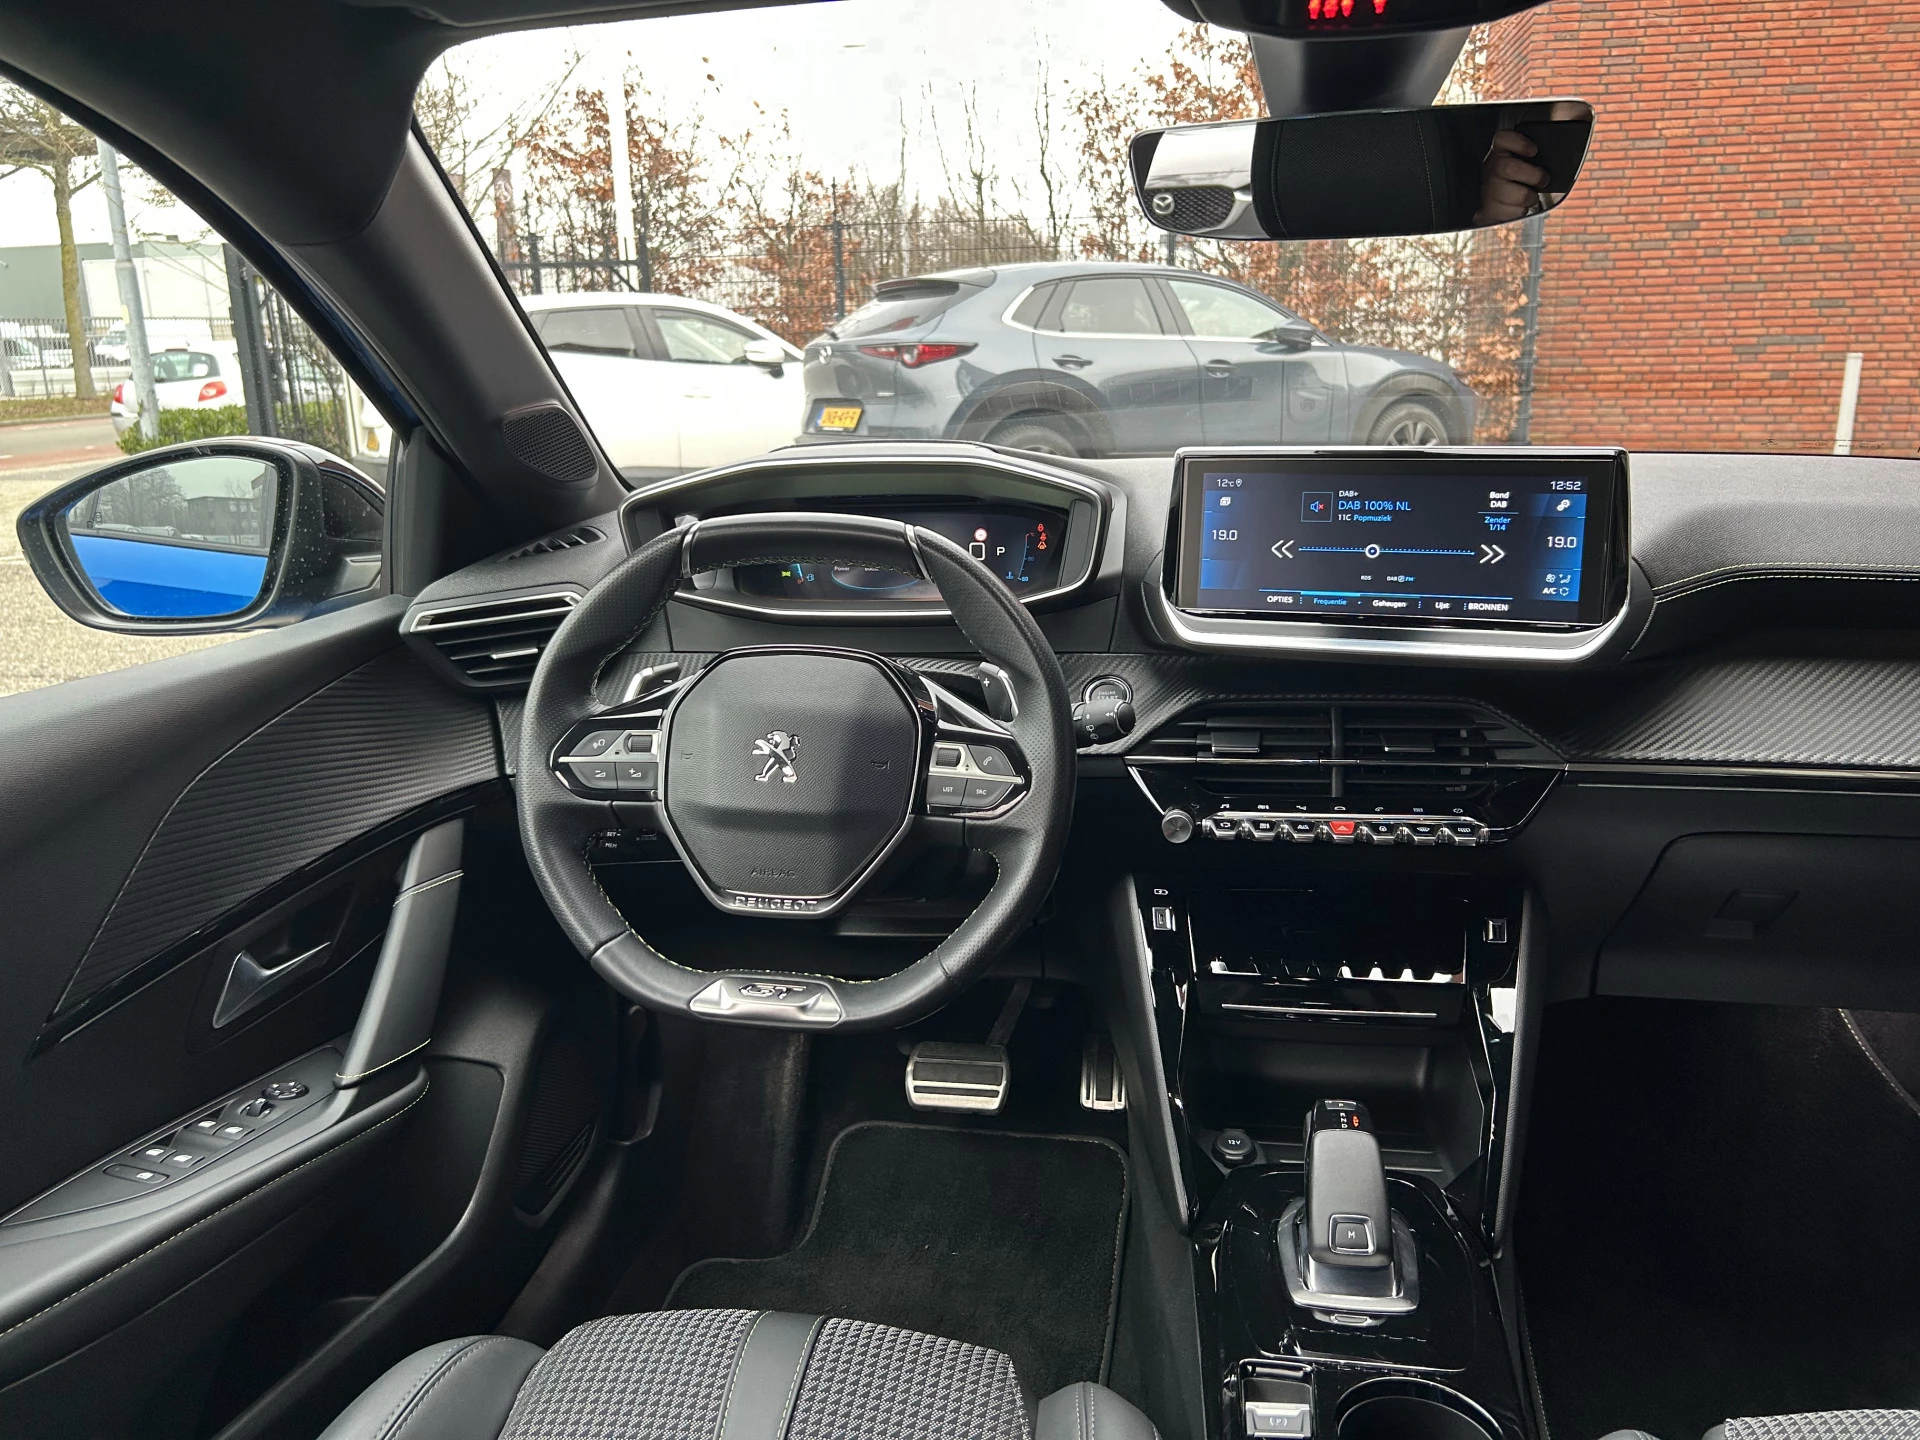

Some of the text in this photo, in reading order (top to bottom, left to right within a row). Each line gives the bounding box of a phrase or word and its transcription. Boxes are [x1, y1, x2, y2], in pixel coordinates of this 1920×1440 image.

[1550, 480, 1581, 491] 12:52
[1338, 490, 1359, 498] DAB+
[1338, 500, 1412, 512] DAB 100% NL
[1490, 500, 1508, 509] DAB
[1338, 513, 1392, 523] 11C Popmuziek
[1484, 516, 1512, 524] Zender
[1489, 523, 1507, 532] 1/14
[1210, 529, 1238, 541] 19.0
[1547, 535, 1578, 549] 19.0
[996, 546, 1006, 556] P
[1266, 595, 1294, 604] OPTIES
[1313, 598, 1348, 607] Frequentie
[1467, 602, 1510, 612] BRONNEN
[975, 788, 987, 796] SRC
[735, 896, 818, 911] PEUGEOT
[1348, 1230, 1356, 1239] M
